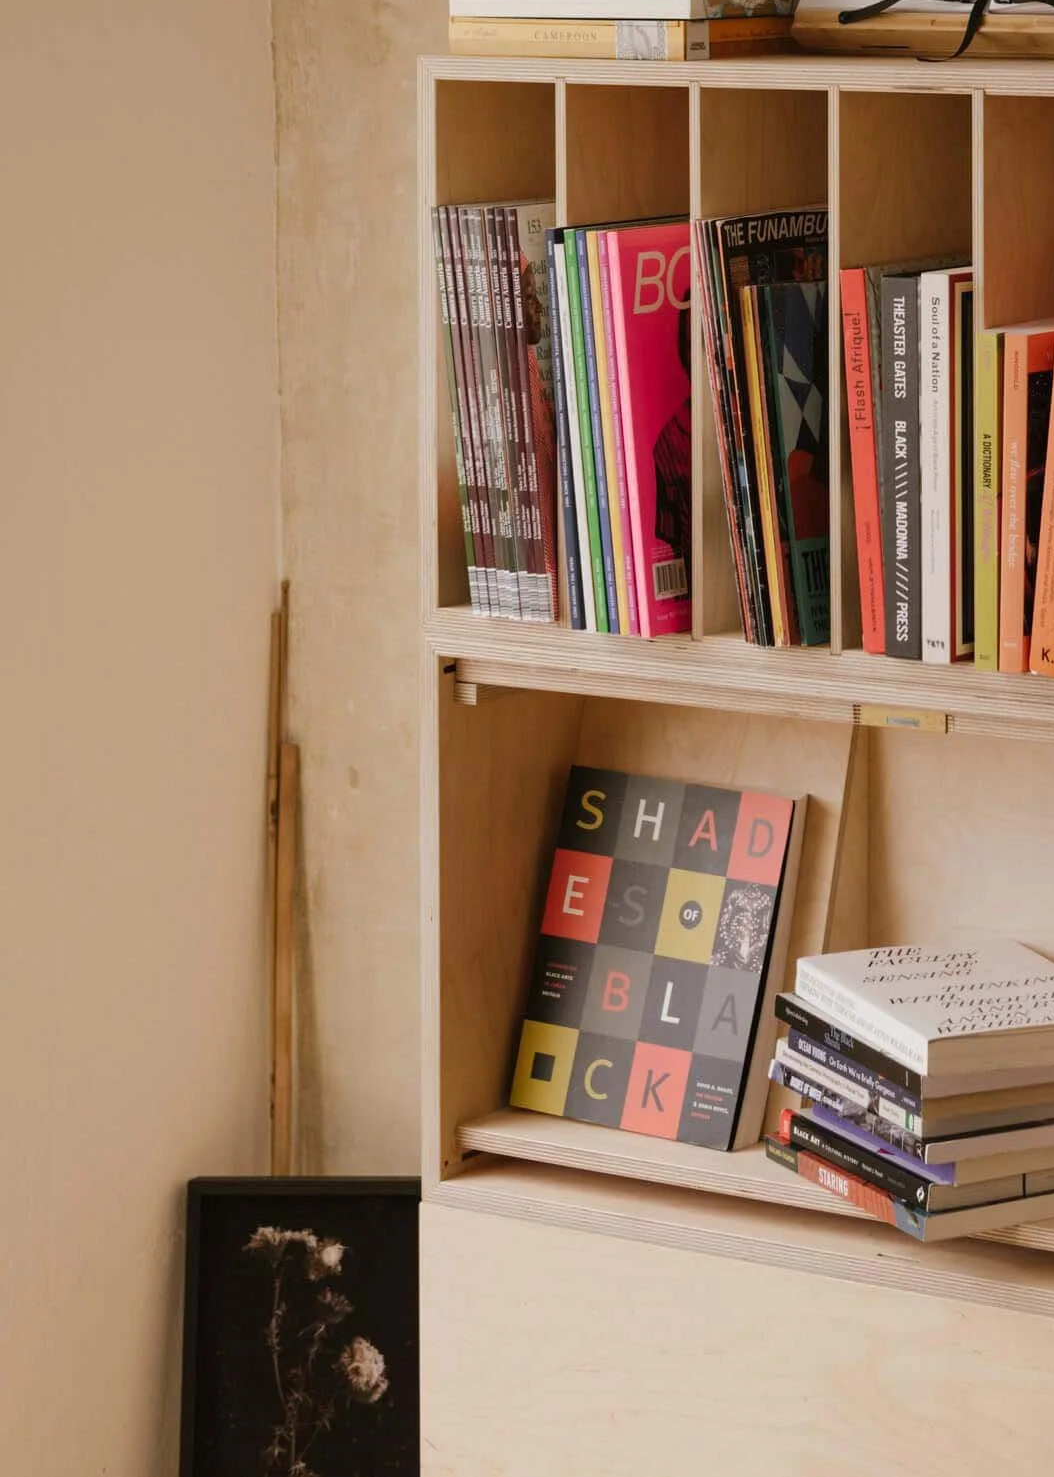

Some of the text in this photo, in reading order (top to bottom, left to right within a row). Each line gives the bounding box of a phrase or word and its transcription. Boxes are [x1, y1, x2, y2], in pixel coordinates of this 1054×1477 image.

[534, 31, 598, 42] CAMEROON
[724, 223, 746, 248] THE
[931, 297, 940, 324] Soul
[845, 312, 864, 373] Afrique!
[932, 327, 940, 340] of
[894, 297, 906, 398] THEASTER GATES
[931, 352, 940, 393] Nation
[894, 420, 907, 459] BLACK
[982, 442, 992, 488] DICTIONARY
[1008, 486, 1016, 508] over
[896, 502, 908, 560] MADONNA
[1009, 512, 1018, 530] the
[1008, 534, 1018, 569] bridge
[896, 602, 908, 642] PRESS
[1042, 648, 1054, 664] K.
[683, 908, 699, 922] OF
[868, 952, 978, 968] FACULTY
[871, 948, 922, 958] THE
[863, 969, 972, 983] SENSING
[944, 960, 978, 970] OF
[940, 1010, 1030, 1024] ANTON
[977, 1002, 1024, 1013] AND
[798, 1038, 811, 1054] OCEAN
[812, 1044, 826, 1062] VUONG
[828, 1056, 835, 1066] On
[836, 1058, 847, 1072] Earth
[874, 1080, 896, 1098] Gorgeous
[794, 1126, 810, 1141] BLACK
[810, 1132, 821, 1147] ART
[818, 1166, 849, 1197] STARING
